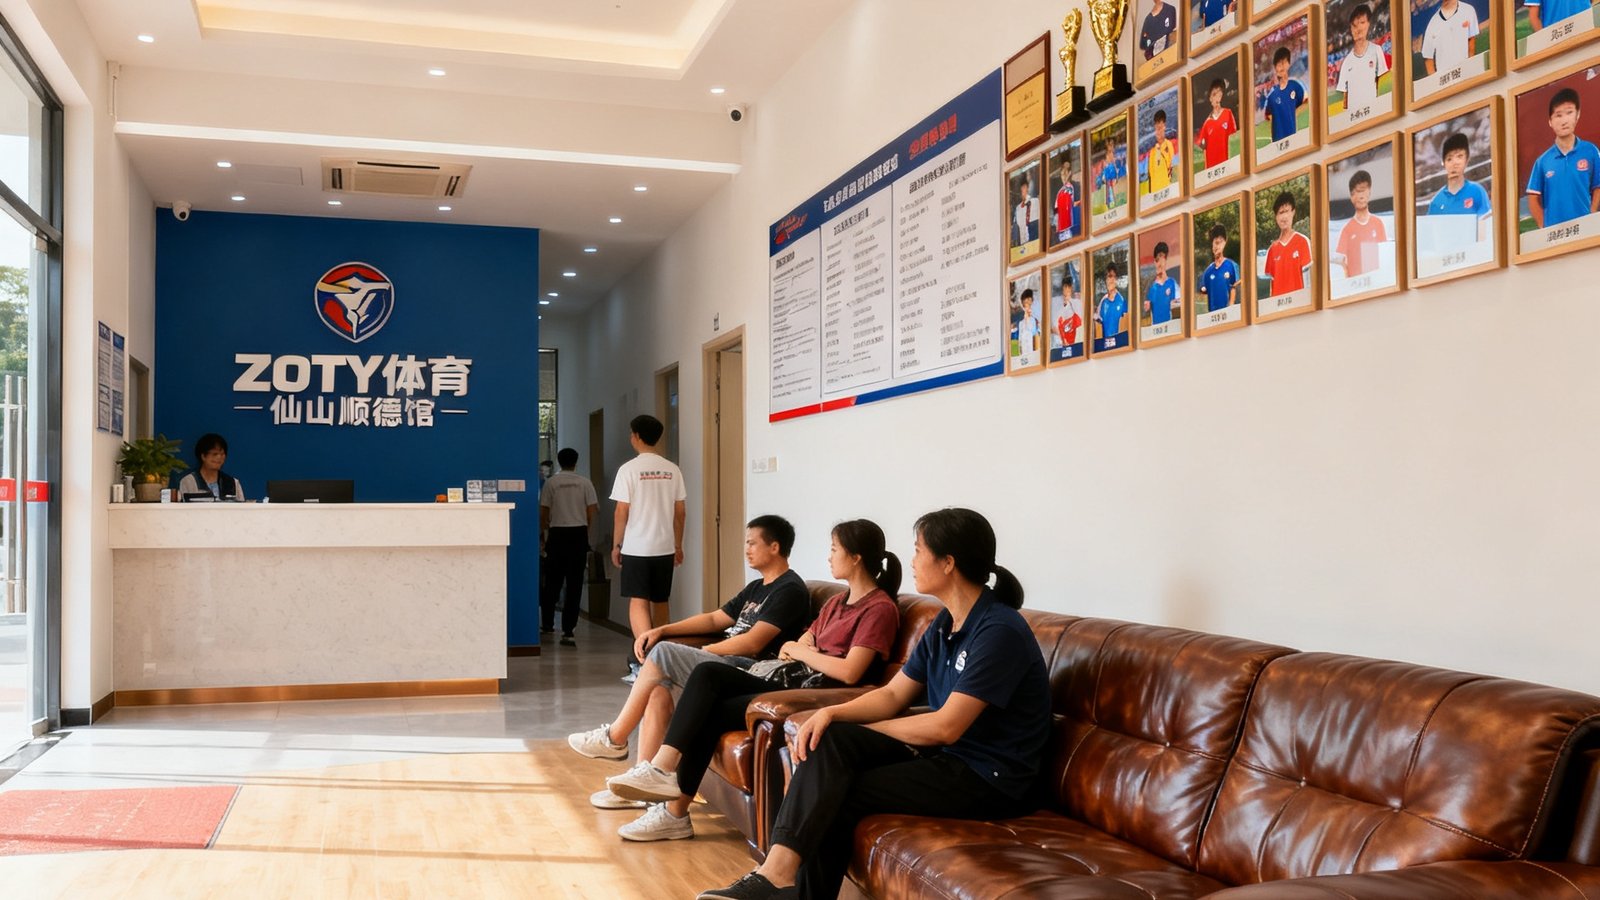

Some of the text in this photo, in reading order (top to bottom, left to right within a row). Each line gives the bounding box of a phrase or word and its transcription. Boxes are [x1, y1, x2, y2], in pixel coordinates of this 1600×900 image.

[233, 353, 472, 396] ZOTY体育
[270, 395, 435, 427] 仙山顺德馆
